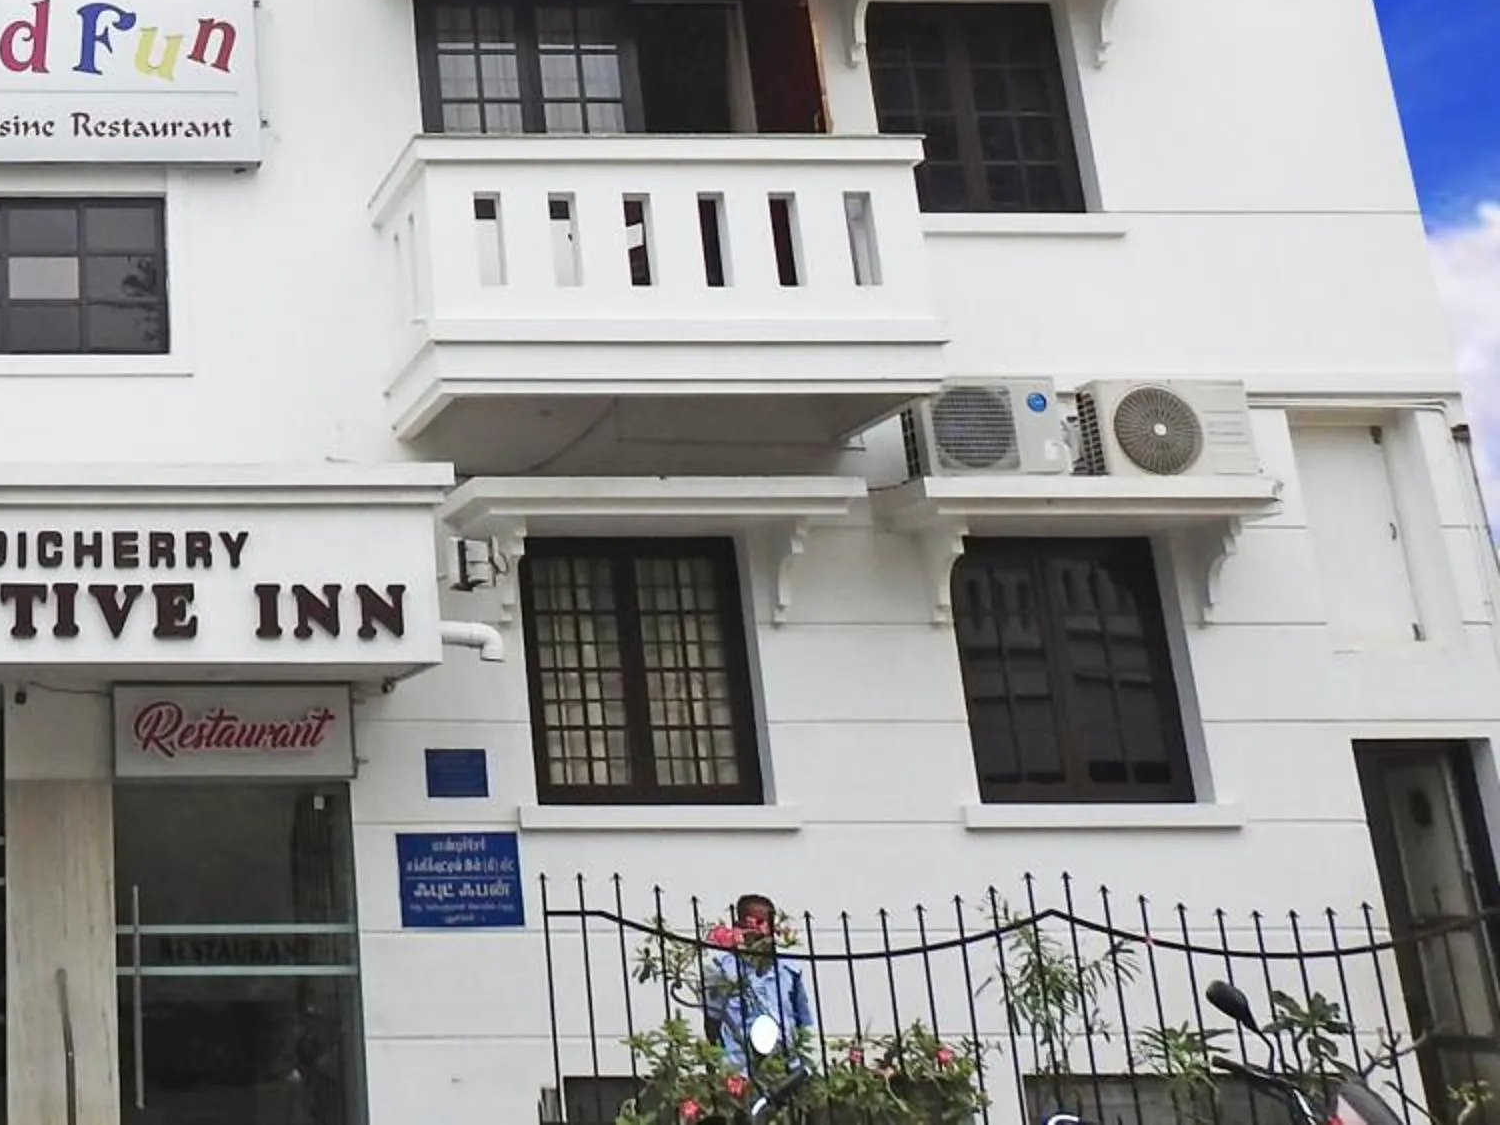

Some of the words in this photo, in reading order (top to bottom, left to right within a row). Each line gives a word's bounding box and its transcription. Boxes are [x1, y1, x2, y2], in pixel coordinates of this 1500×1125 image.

[72, 2, 238, 81] Fun
[71, 111, 233, 138] Restaurant
[254, 583, 407, 641] INN
[134, 701, 336, 758] Restaurant
